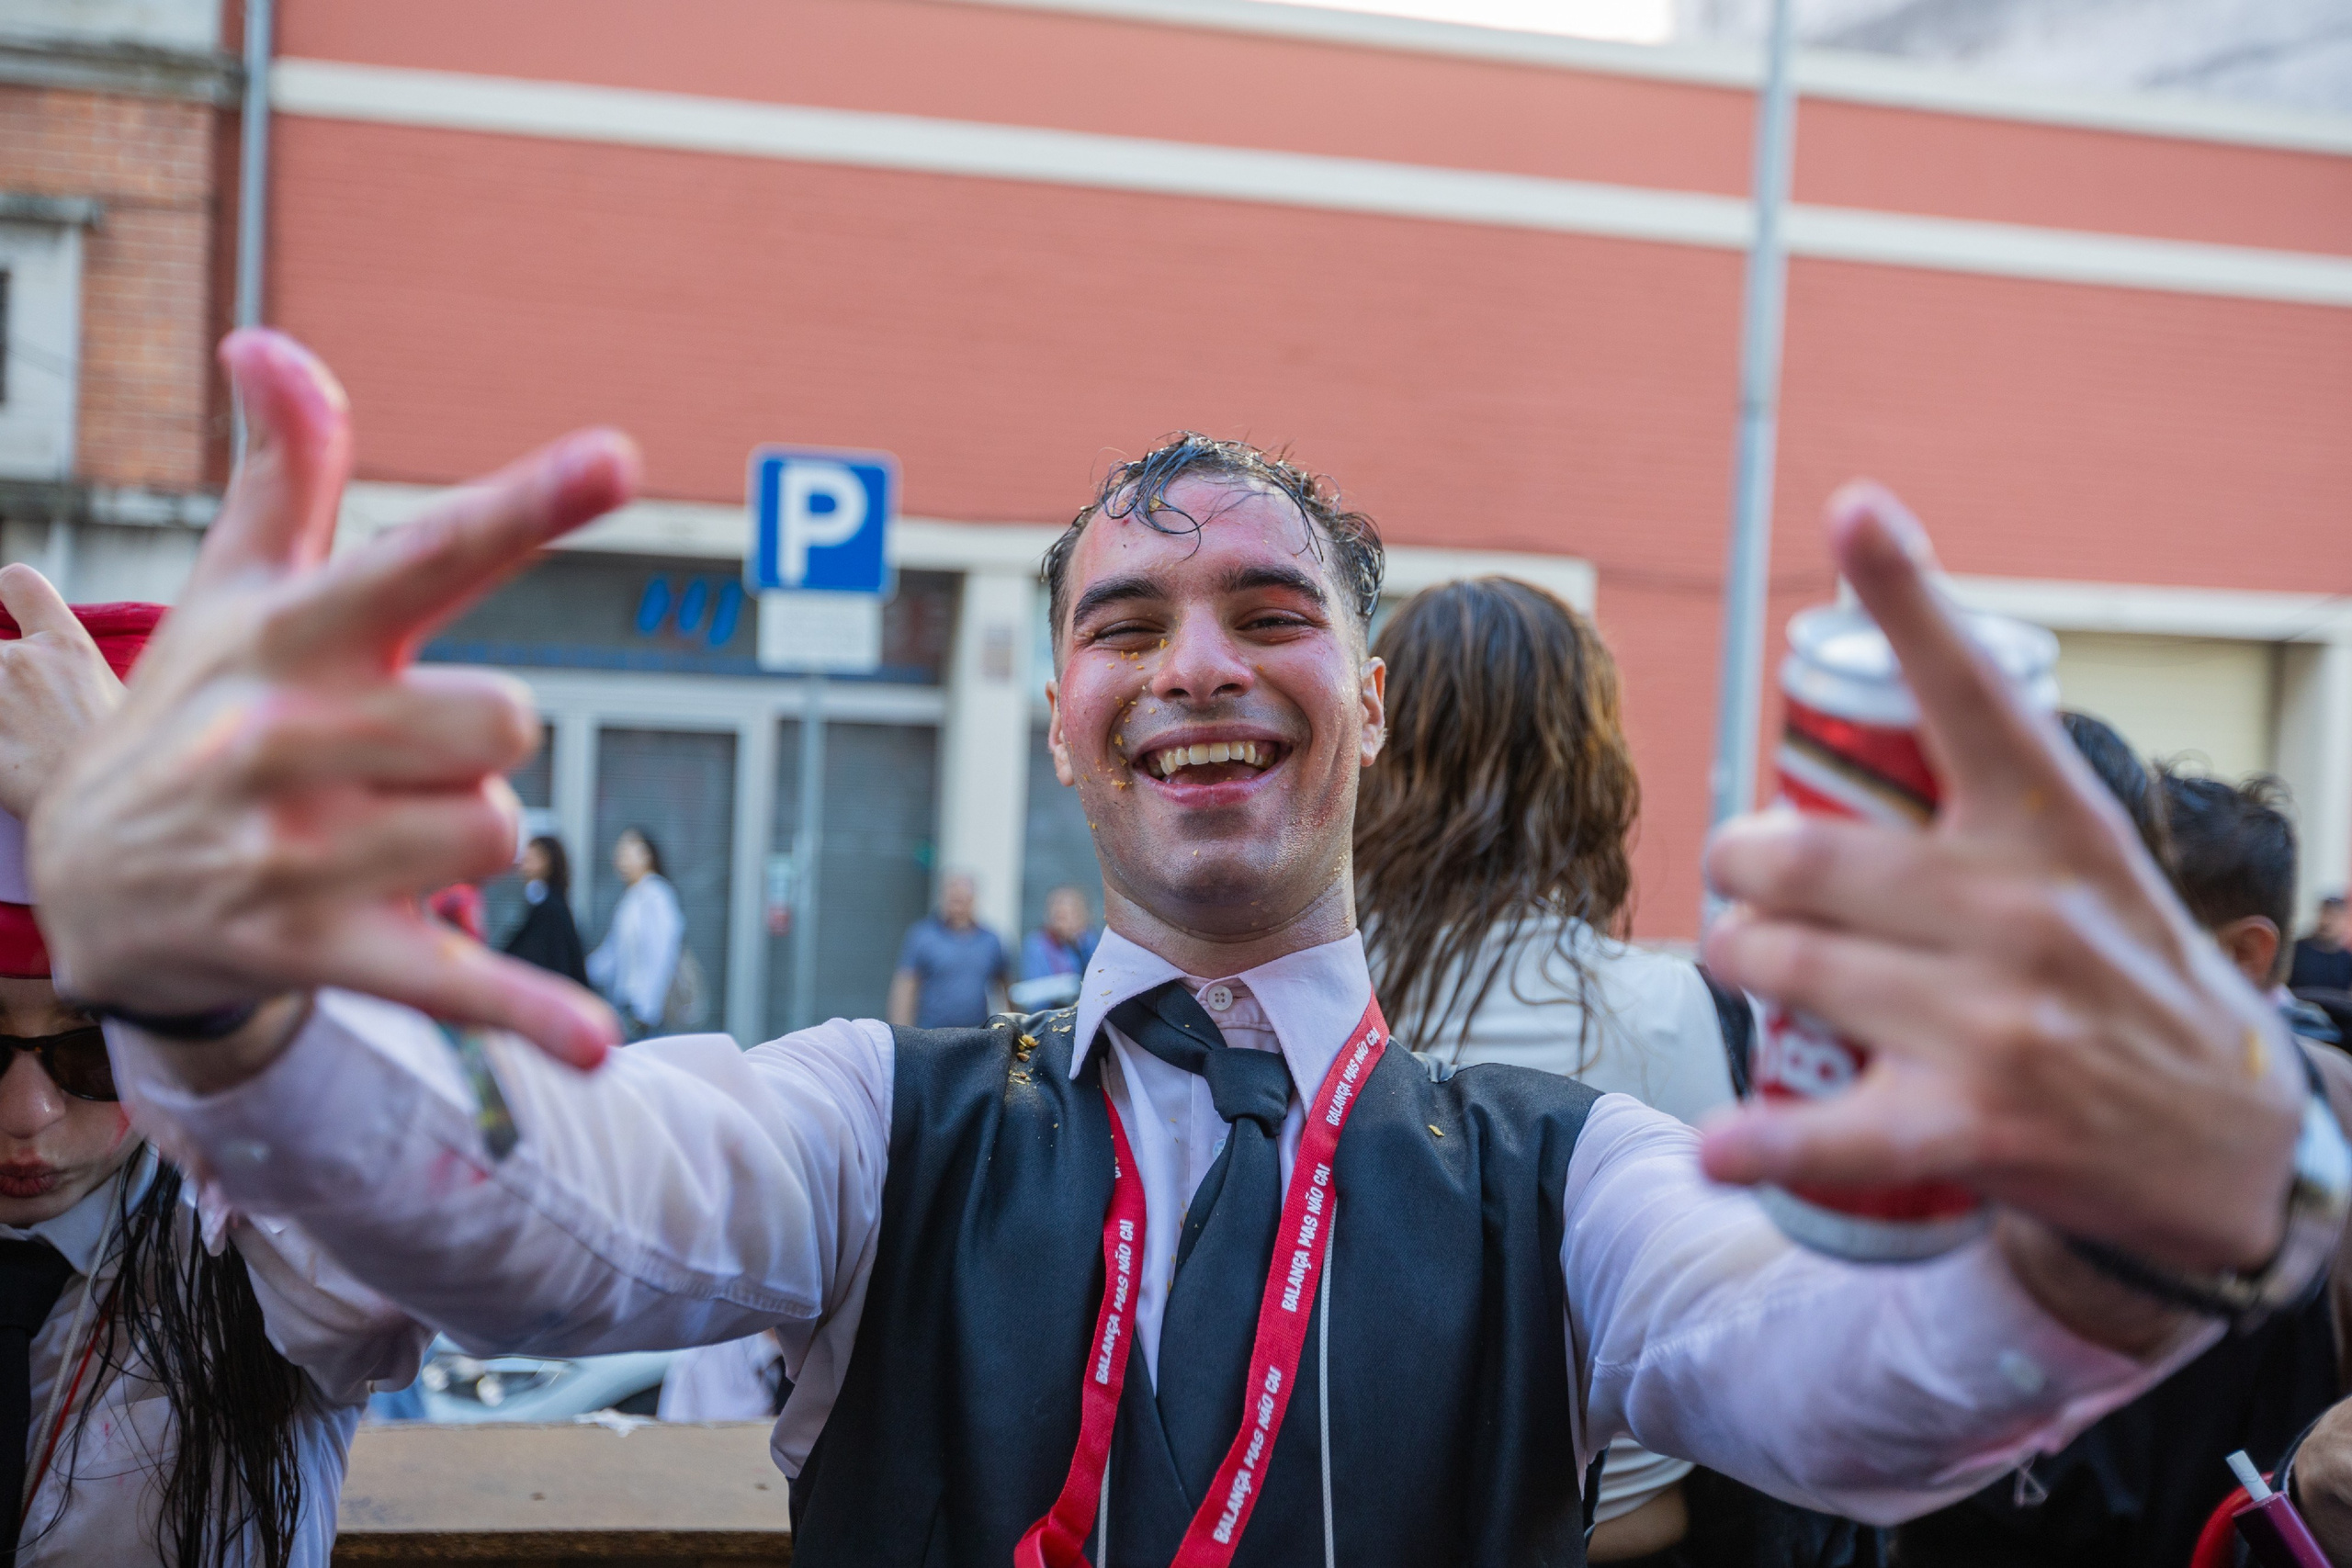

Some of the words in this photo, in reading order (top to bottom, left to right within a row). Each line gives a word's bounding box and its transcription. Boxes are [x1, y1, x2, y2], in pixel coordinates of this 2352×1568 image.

[775, 457, 869, 586] P
[1326, 1080, 1352, 1126] BALANÇA
[1342, 1059, 1360, 1083] MAS
[1354, 1040, 1370, 1065] NÃO
[1313, 1162, 1331, 1187] CAI
[1305, 1186, 1324, 1215] NÃO
[1119, 1219, 1134, 1242] CAI
[1297, 1214, 1318, 1247] MAS
[1114, 1243, 1132, 1275] NÃO
[1114, 1274, 1128, 1313] MAS
[1282, 1249, 1311, 1313] BALANÇA
[1095, 1314, 1121, 1385] BALANÇA
[1265, 1365, 1282, 1394] CAI
[1257, 1393, 1274, 1431] NÃO
[1243, 1427, 1264, 1470] MAS
[1212, 1469, 1251, 1544] BALANÇA
